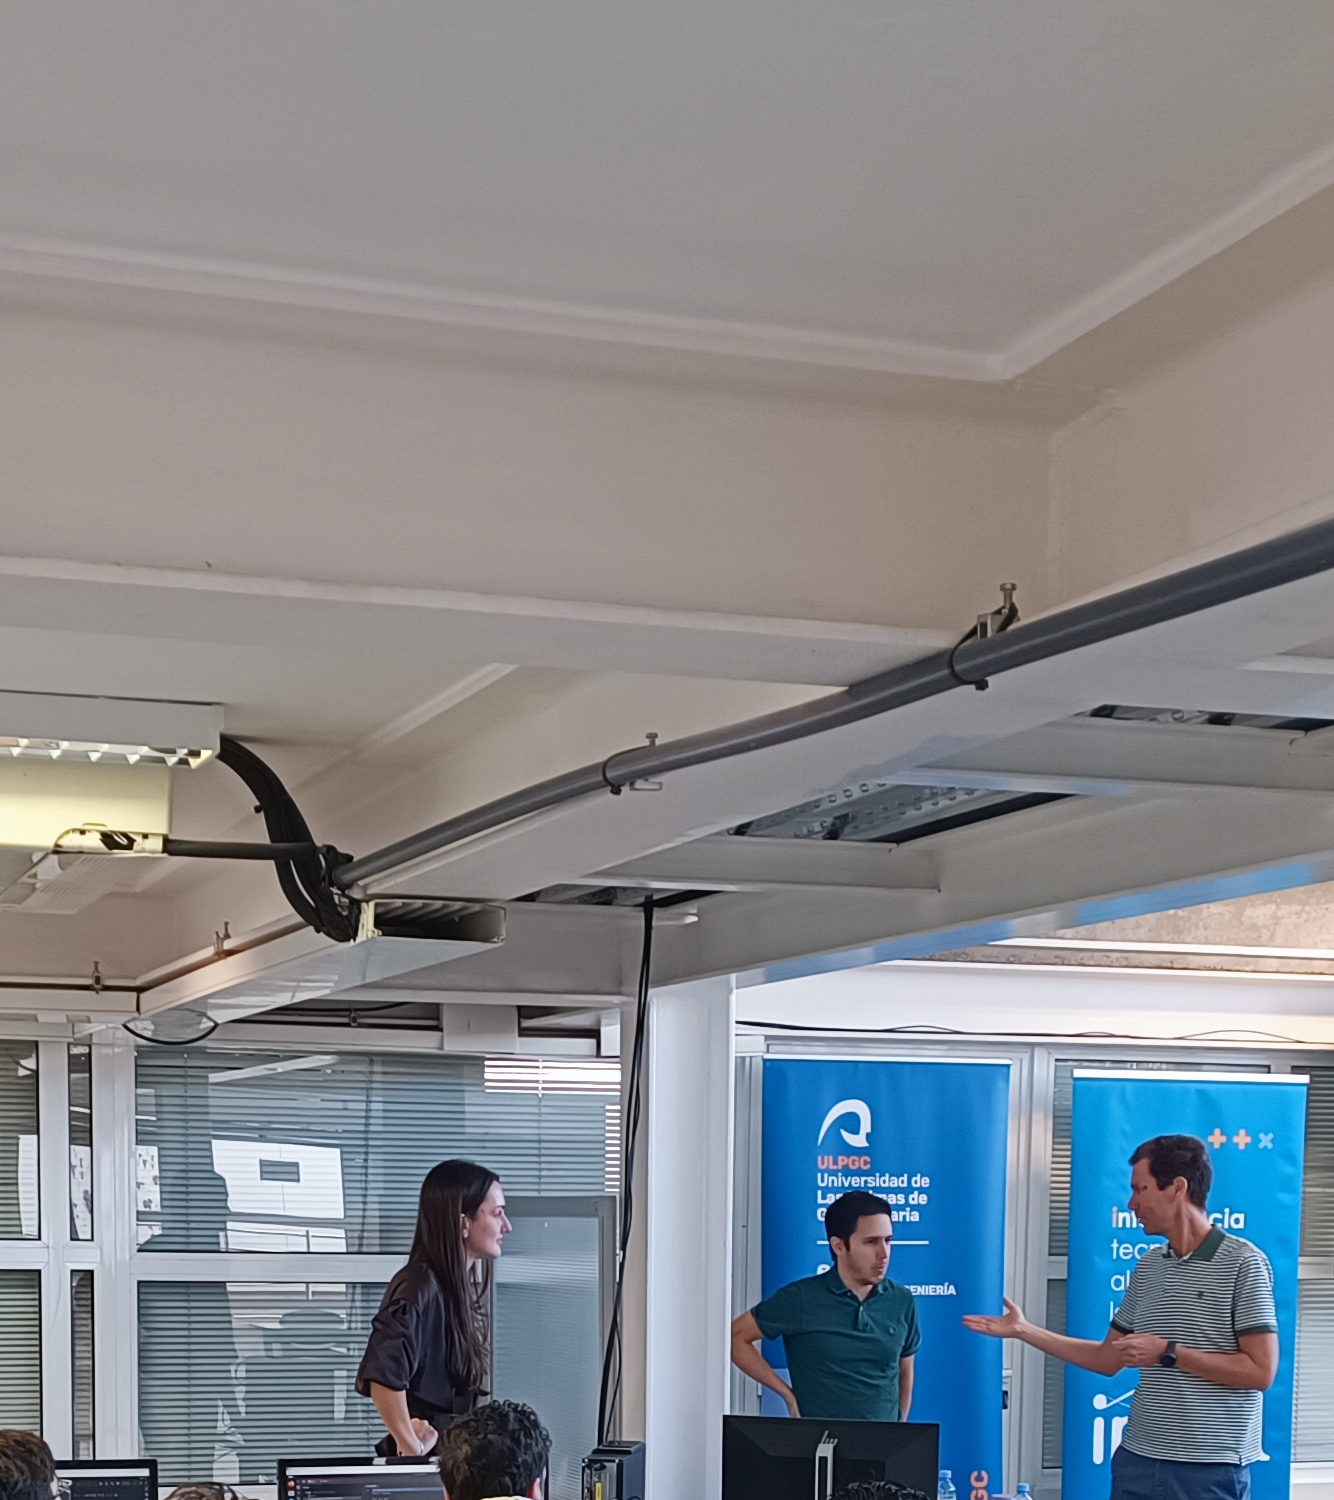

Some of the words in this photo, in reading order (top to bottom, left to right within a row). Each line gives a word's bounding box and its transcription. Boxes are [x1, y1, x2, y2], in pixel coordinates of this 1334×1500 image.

[817, 1155, 871, 1170] ULPGC
[817, 1172, 908, 1188] Universidad
[911, 1173, 930, 1188] de
[909, 1190, 928, 1205] de
